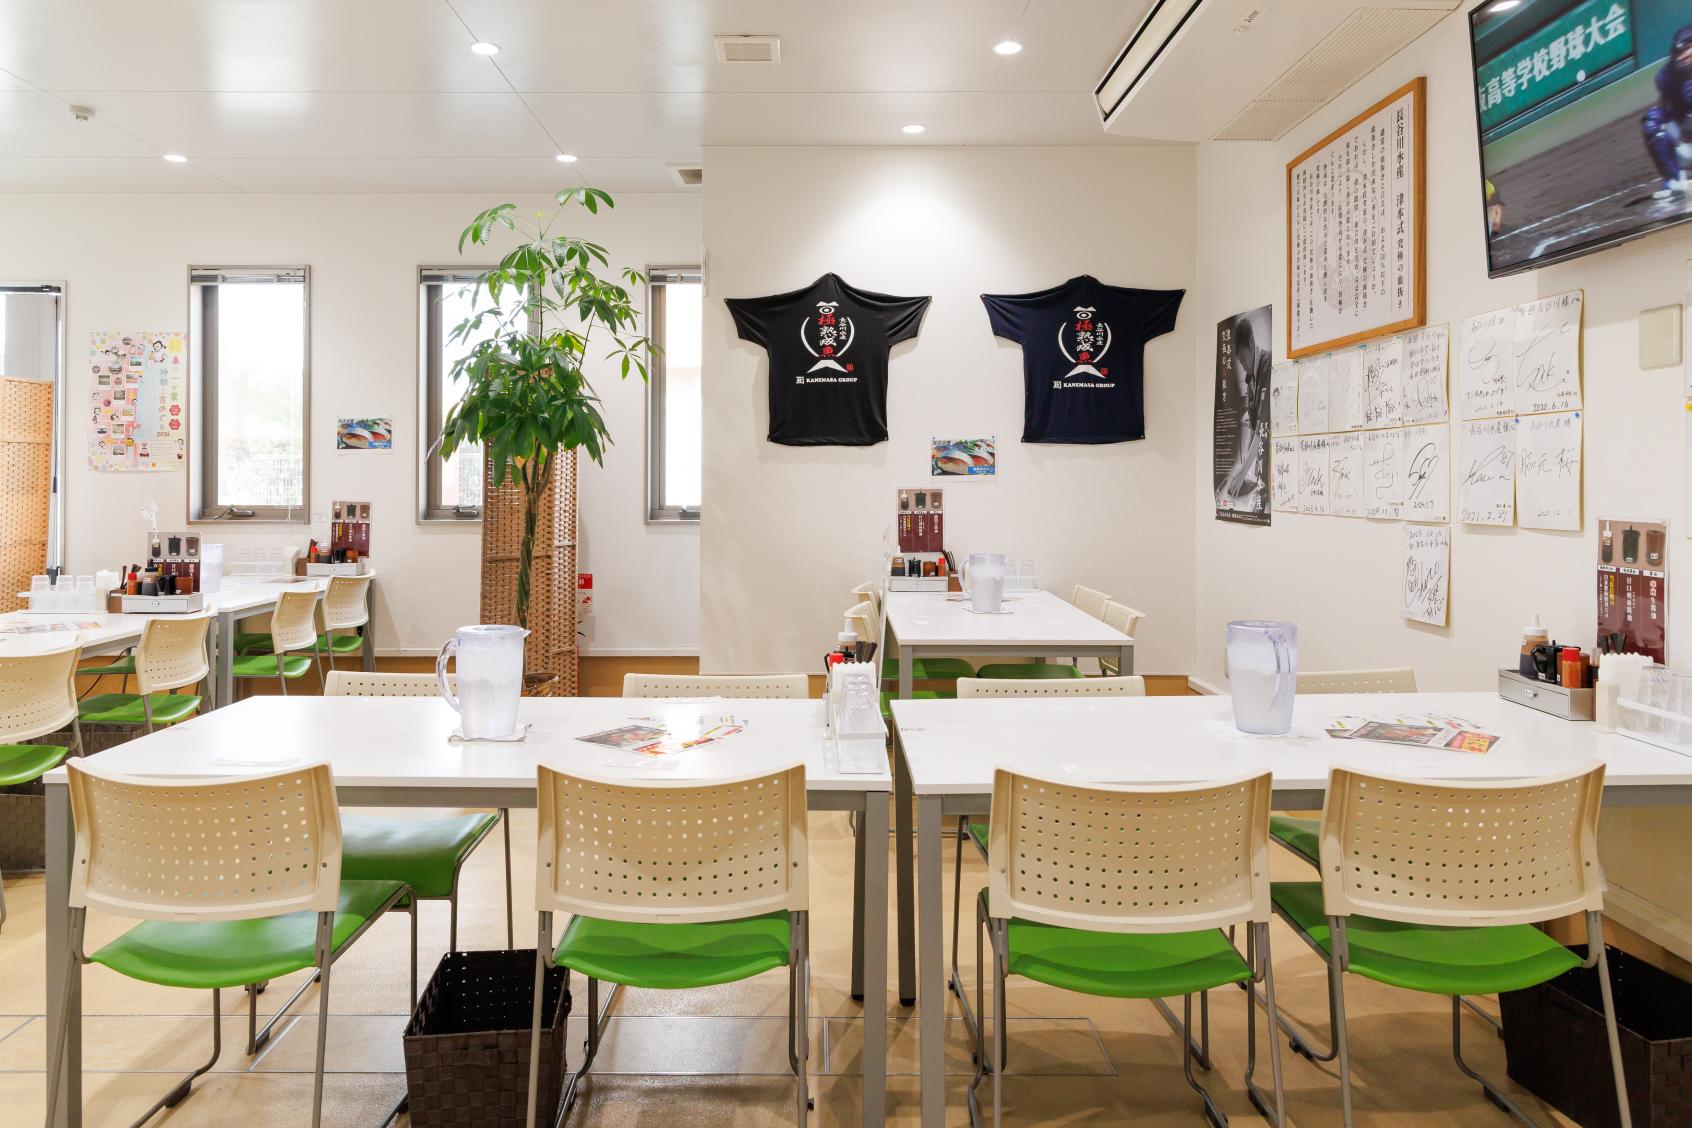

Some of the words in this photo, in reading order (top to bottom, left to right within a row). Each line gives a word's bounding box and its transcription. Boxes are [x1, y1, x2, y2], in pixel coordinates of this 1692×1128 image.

[1396, 107, 1405, 179] 長谷川水産
